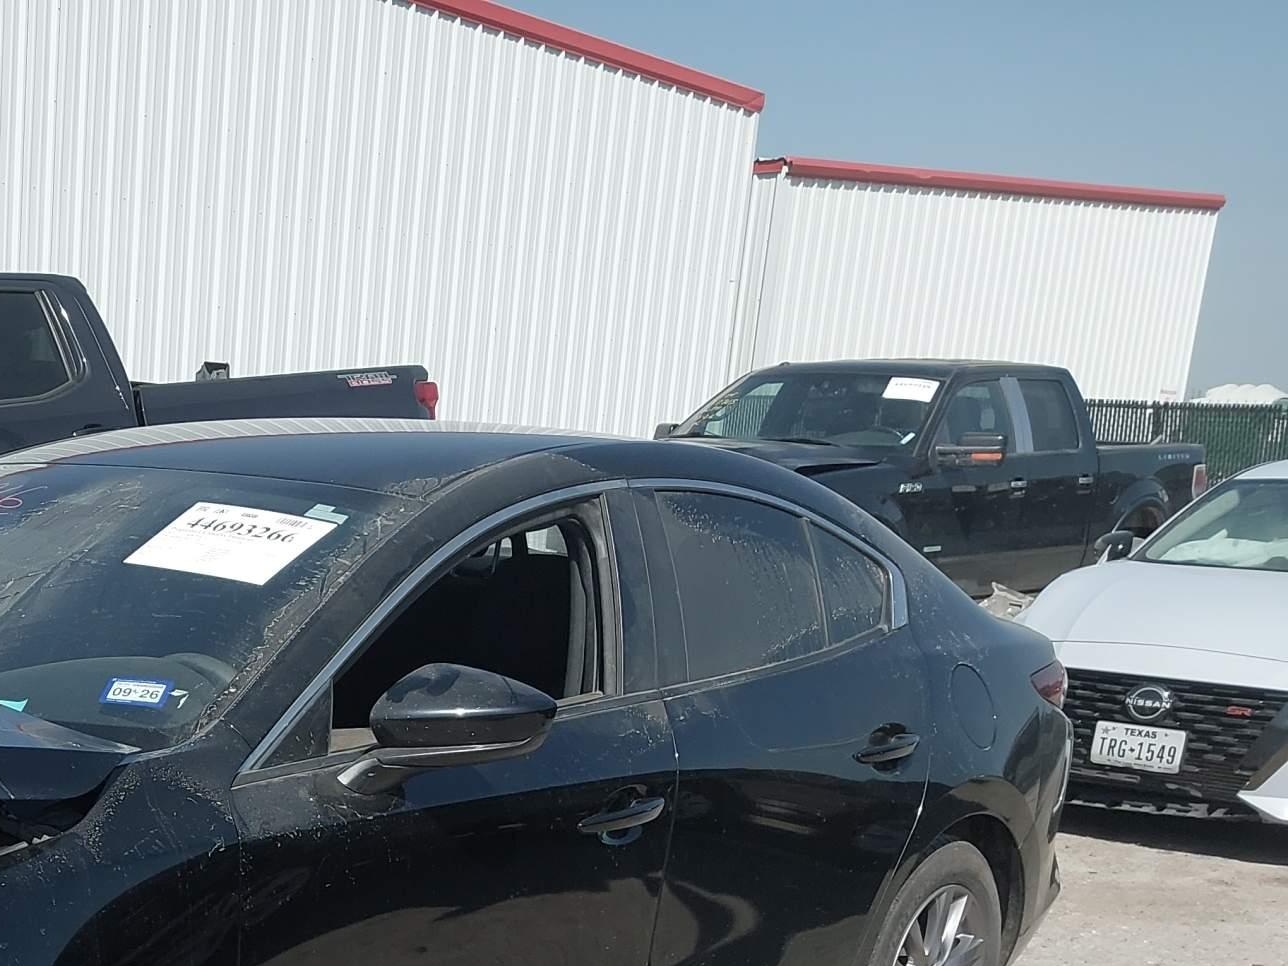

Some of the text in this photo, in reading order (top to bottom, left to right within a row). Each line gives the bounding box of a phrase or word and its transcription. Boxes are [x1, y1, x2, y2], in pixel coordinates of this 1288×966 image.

[187, 517, 299, 543] 44693266
[112, 687, 161, 699] 09 26
[1125, 697, 1173, 709] NISSAN
[1225, 705, 1254, 717] SR
[1124, 727, 1158, 739] TEXAS
[1099, 737, 1128, 758] TRG
[1134, 741, 1177, 765] 1549
